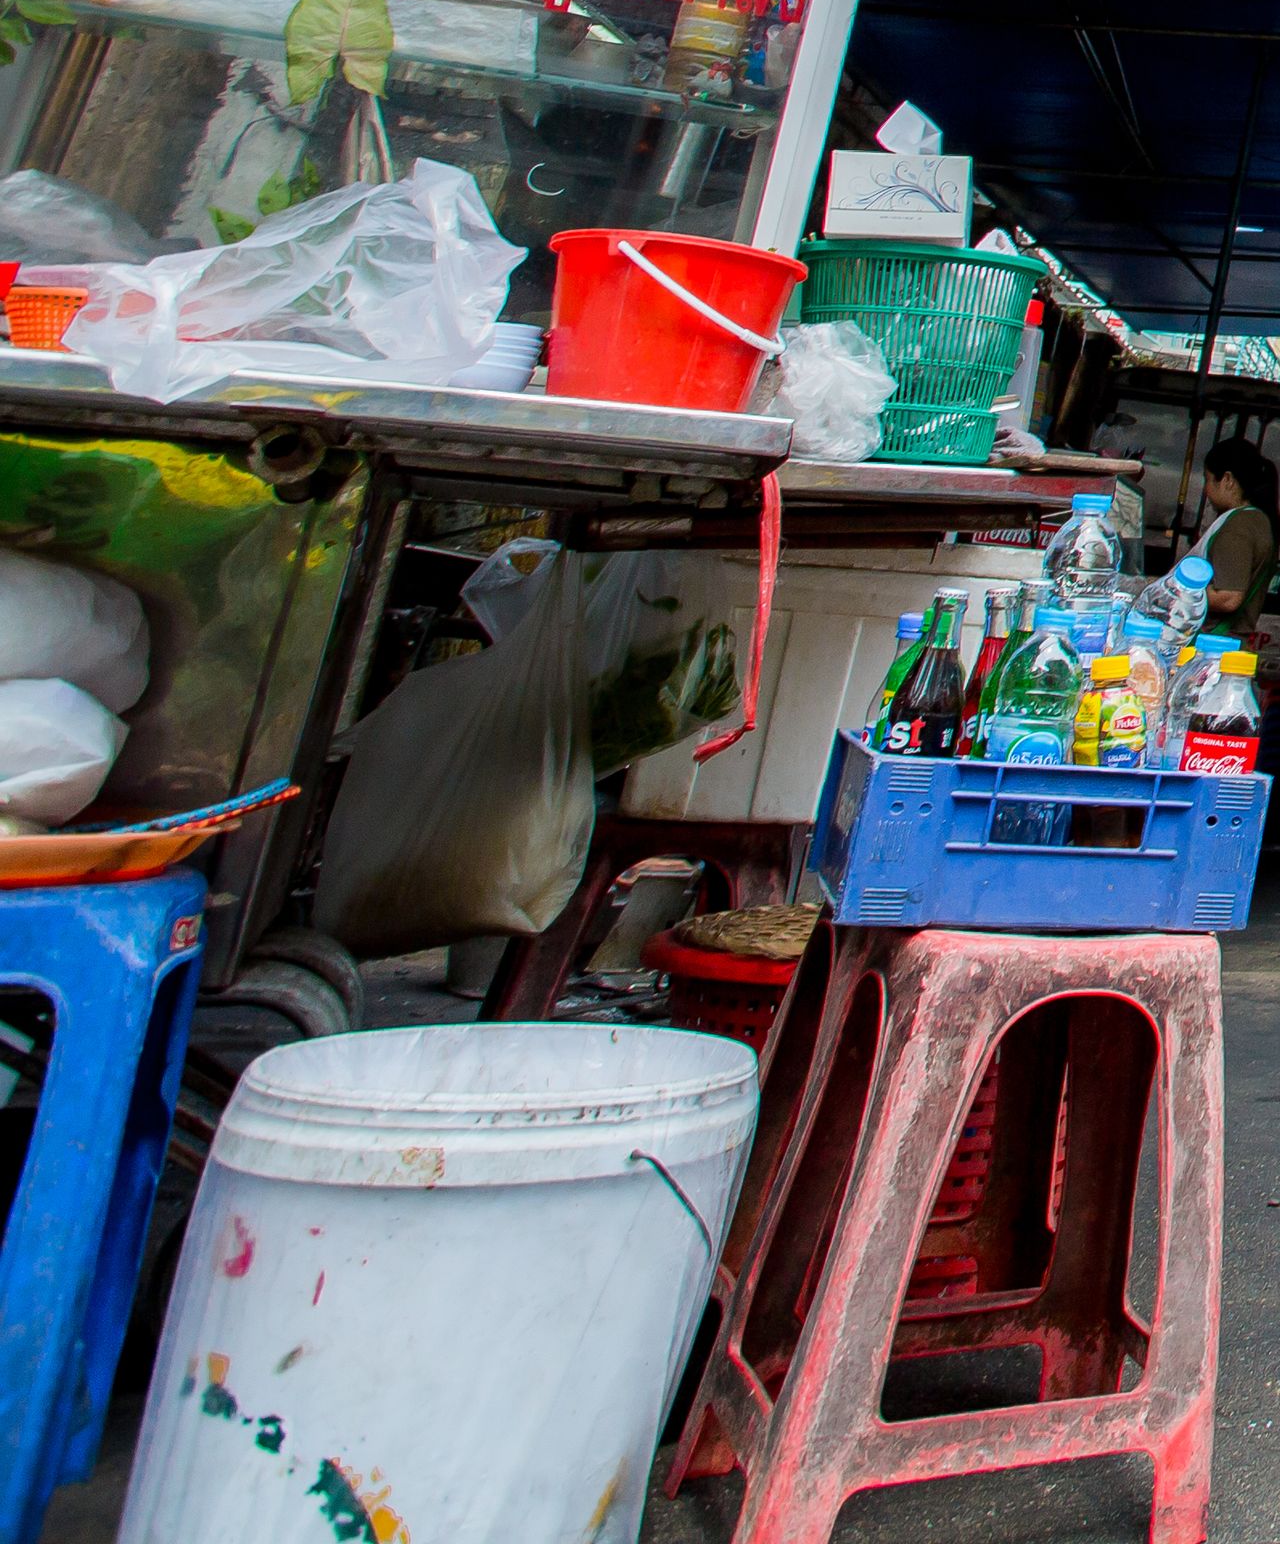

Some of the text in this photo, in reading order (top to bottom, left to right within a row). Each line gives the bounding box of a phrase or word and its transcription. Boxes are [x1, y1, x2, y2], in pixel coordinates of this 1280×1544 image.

[1192, 737, 1248, 749] ORIGINAL TASTE
[1185, 751, 1248, 775] Coca-Cola
